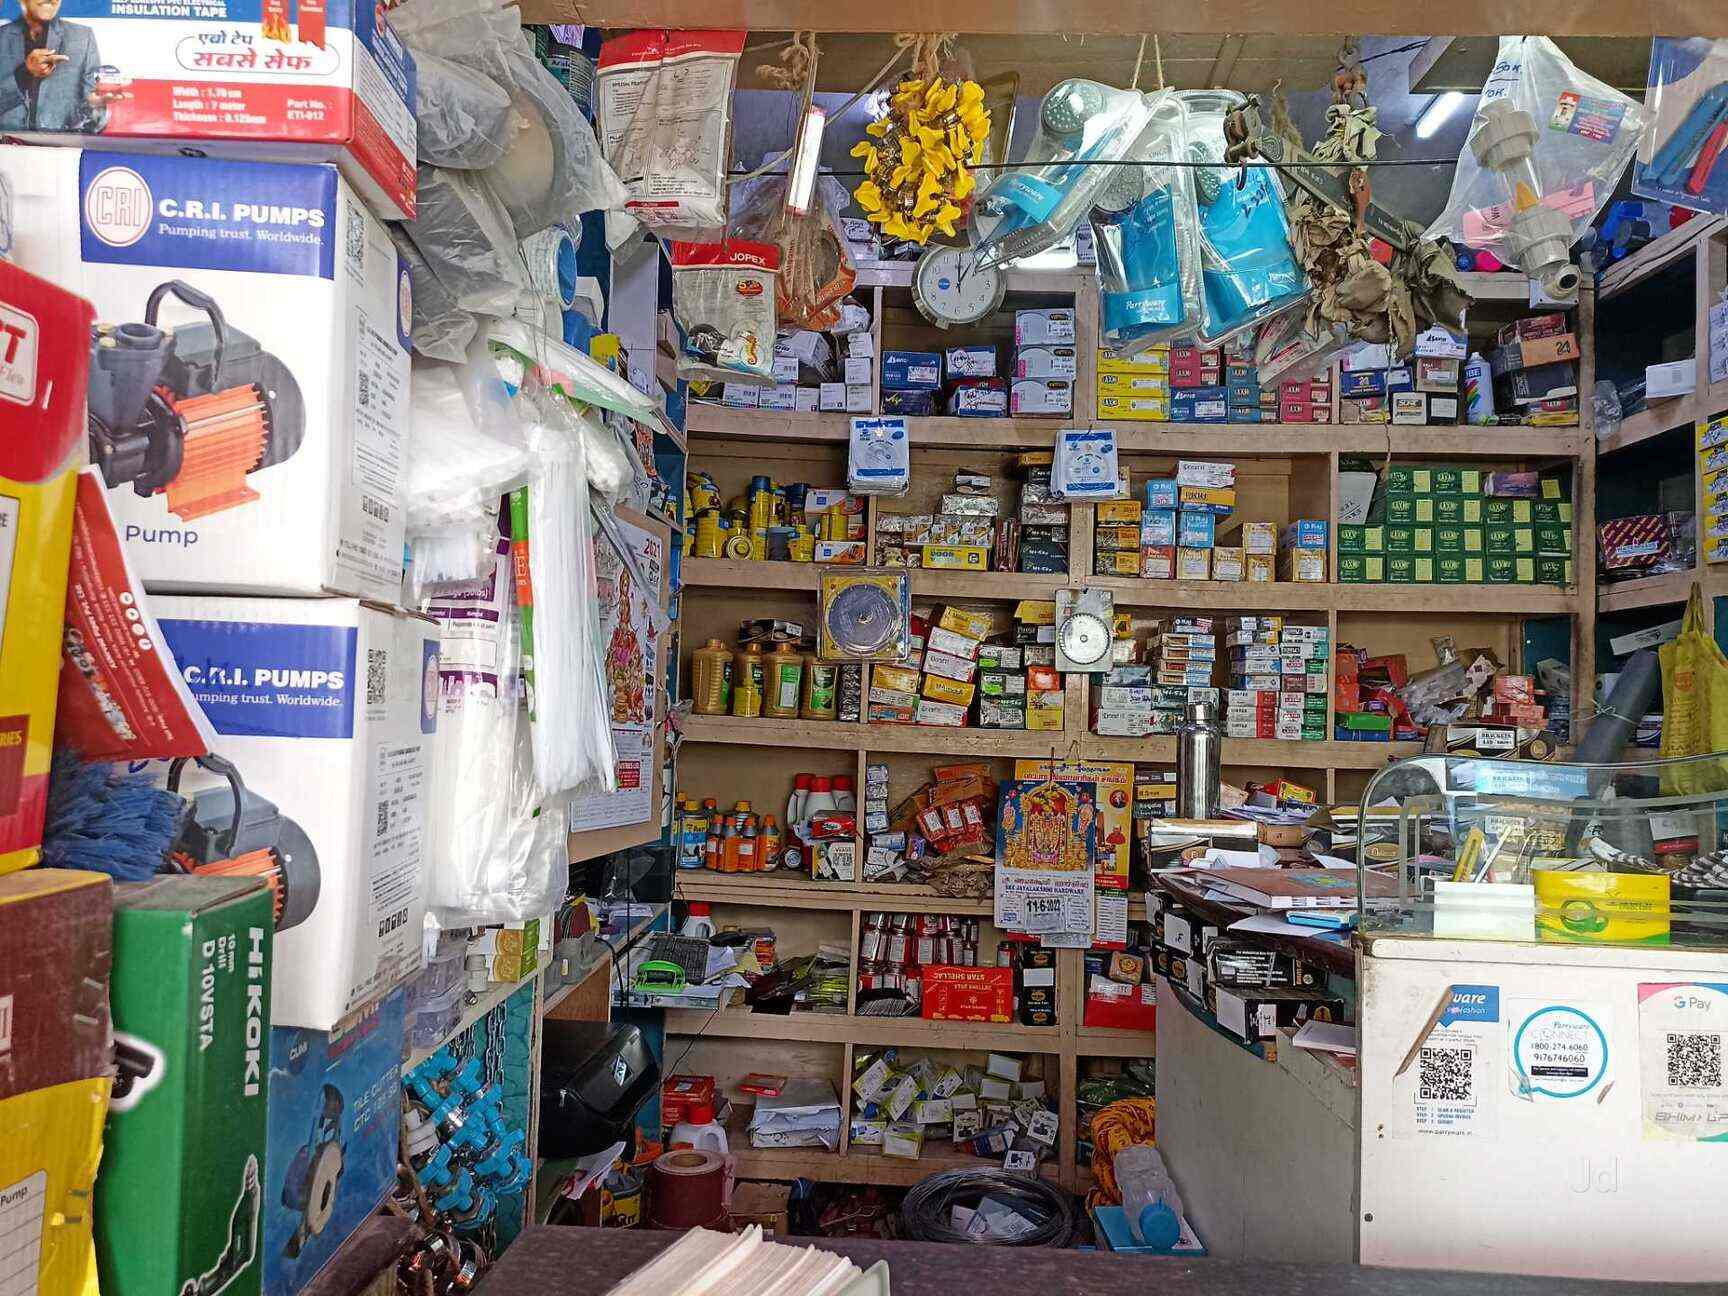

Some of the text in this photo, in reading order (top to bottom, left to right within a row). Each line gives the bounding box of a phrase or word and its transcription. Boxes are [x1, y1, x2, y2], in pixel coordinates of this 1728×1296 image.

[112, 4, 227, 18] INSULATION TAPE
[96, 184, 142, 228] CRI
[158, 198, 325, 227] C.R.I. PUMPS
[158, 224, 216, 240] Pumping
[256, 230, 325, 246] Worldwide.
[730, 252, 766, 266] JOPEX
[125, 525, 199, 548] Pump
[185, 667, 344, 690] C.R.I. PUMPS
[191, 691, 238, 706] umping
[216, 936, 227, 969] Drill
[199, 939, 216, 1052] D 10VSTA
[1674, 996, 1711, 1012] G Pay
[244, 926, 265, 1097] HiKOKI
[1531, 1042, 1549, 1050] 1800
[1552, 1043, 1566, 1051] 274
